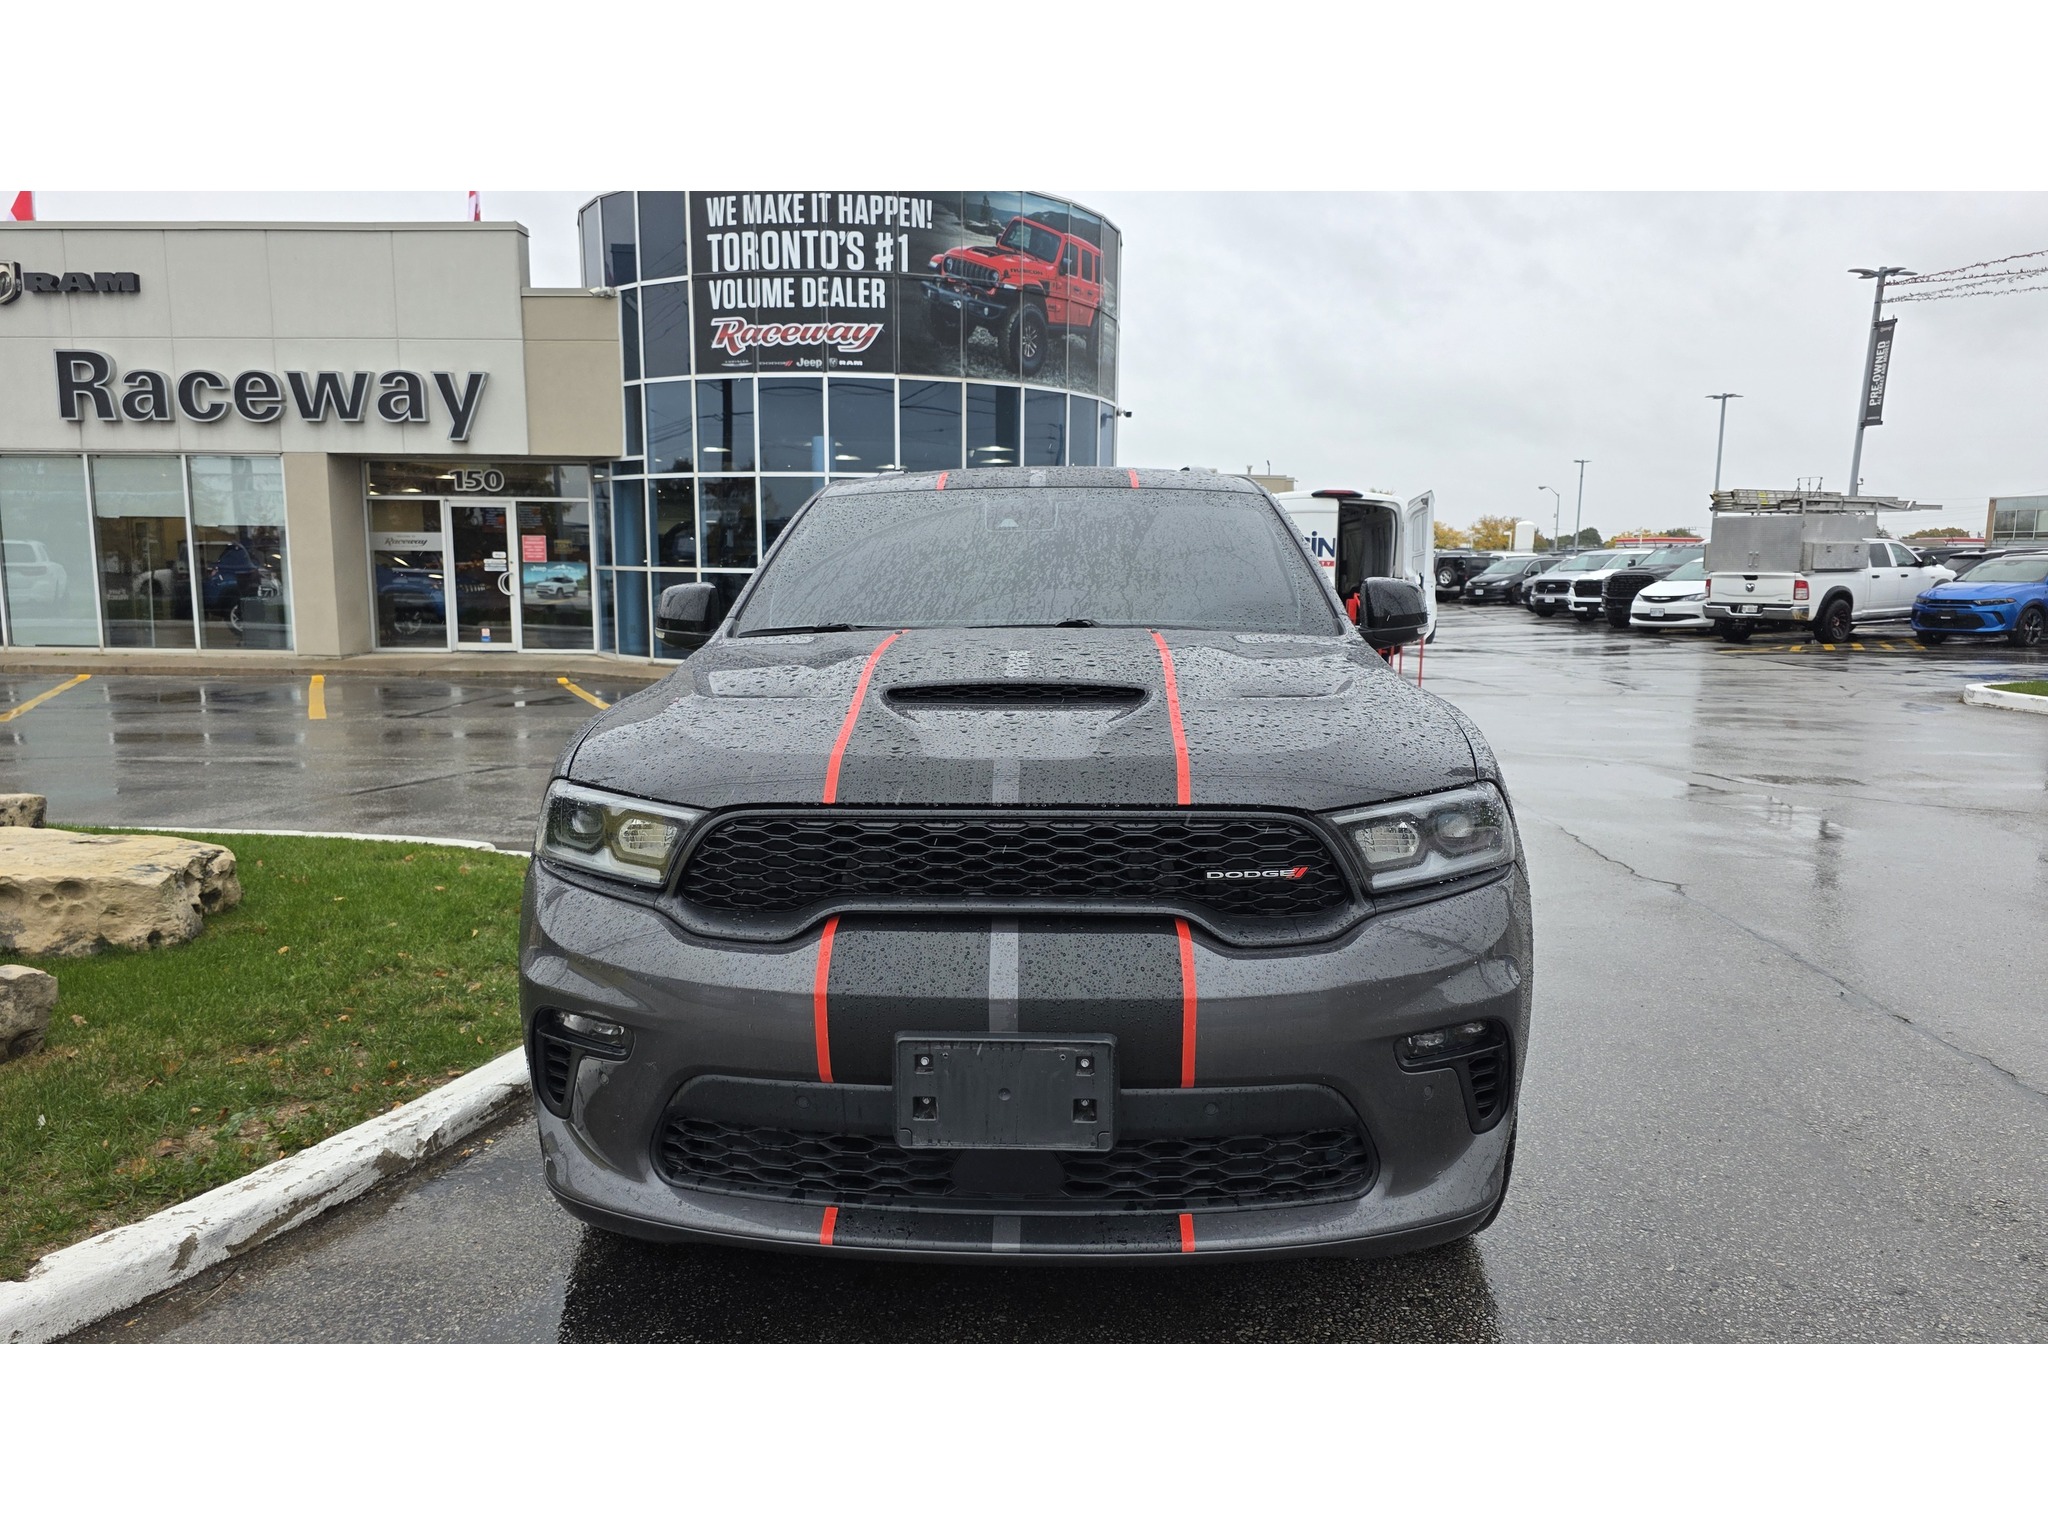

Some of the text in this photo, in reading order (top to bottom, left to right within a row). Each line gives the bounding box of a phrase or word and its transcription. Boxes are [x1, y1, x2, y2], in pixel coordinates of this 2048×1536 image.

[706, 193, 933, 229] WE MAKE IT HAPPEN!
[707, 230, 909, 272] TORONTO'S #1
[23, 272, 140, 293] RAM
[708, 276, 886, 310] VOLUME DEALER
[711, 316, 885, 356] Raceway
[796, 358, 822, 368] Jeep
[1869, 340, 1886, 406] PRE-OWNED
[53, 349, 489, 442] Raceway
[448, 469, 505, 492] 150
[1206, 870, 1296, 879] DODGE
